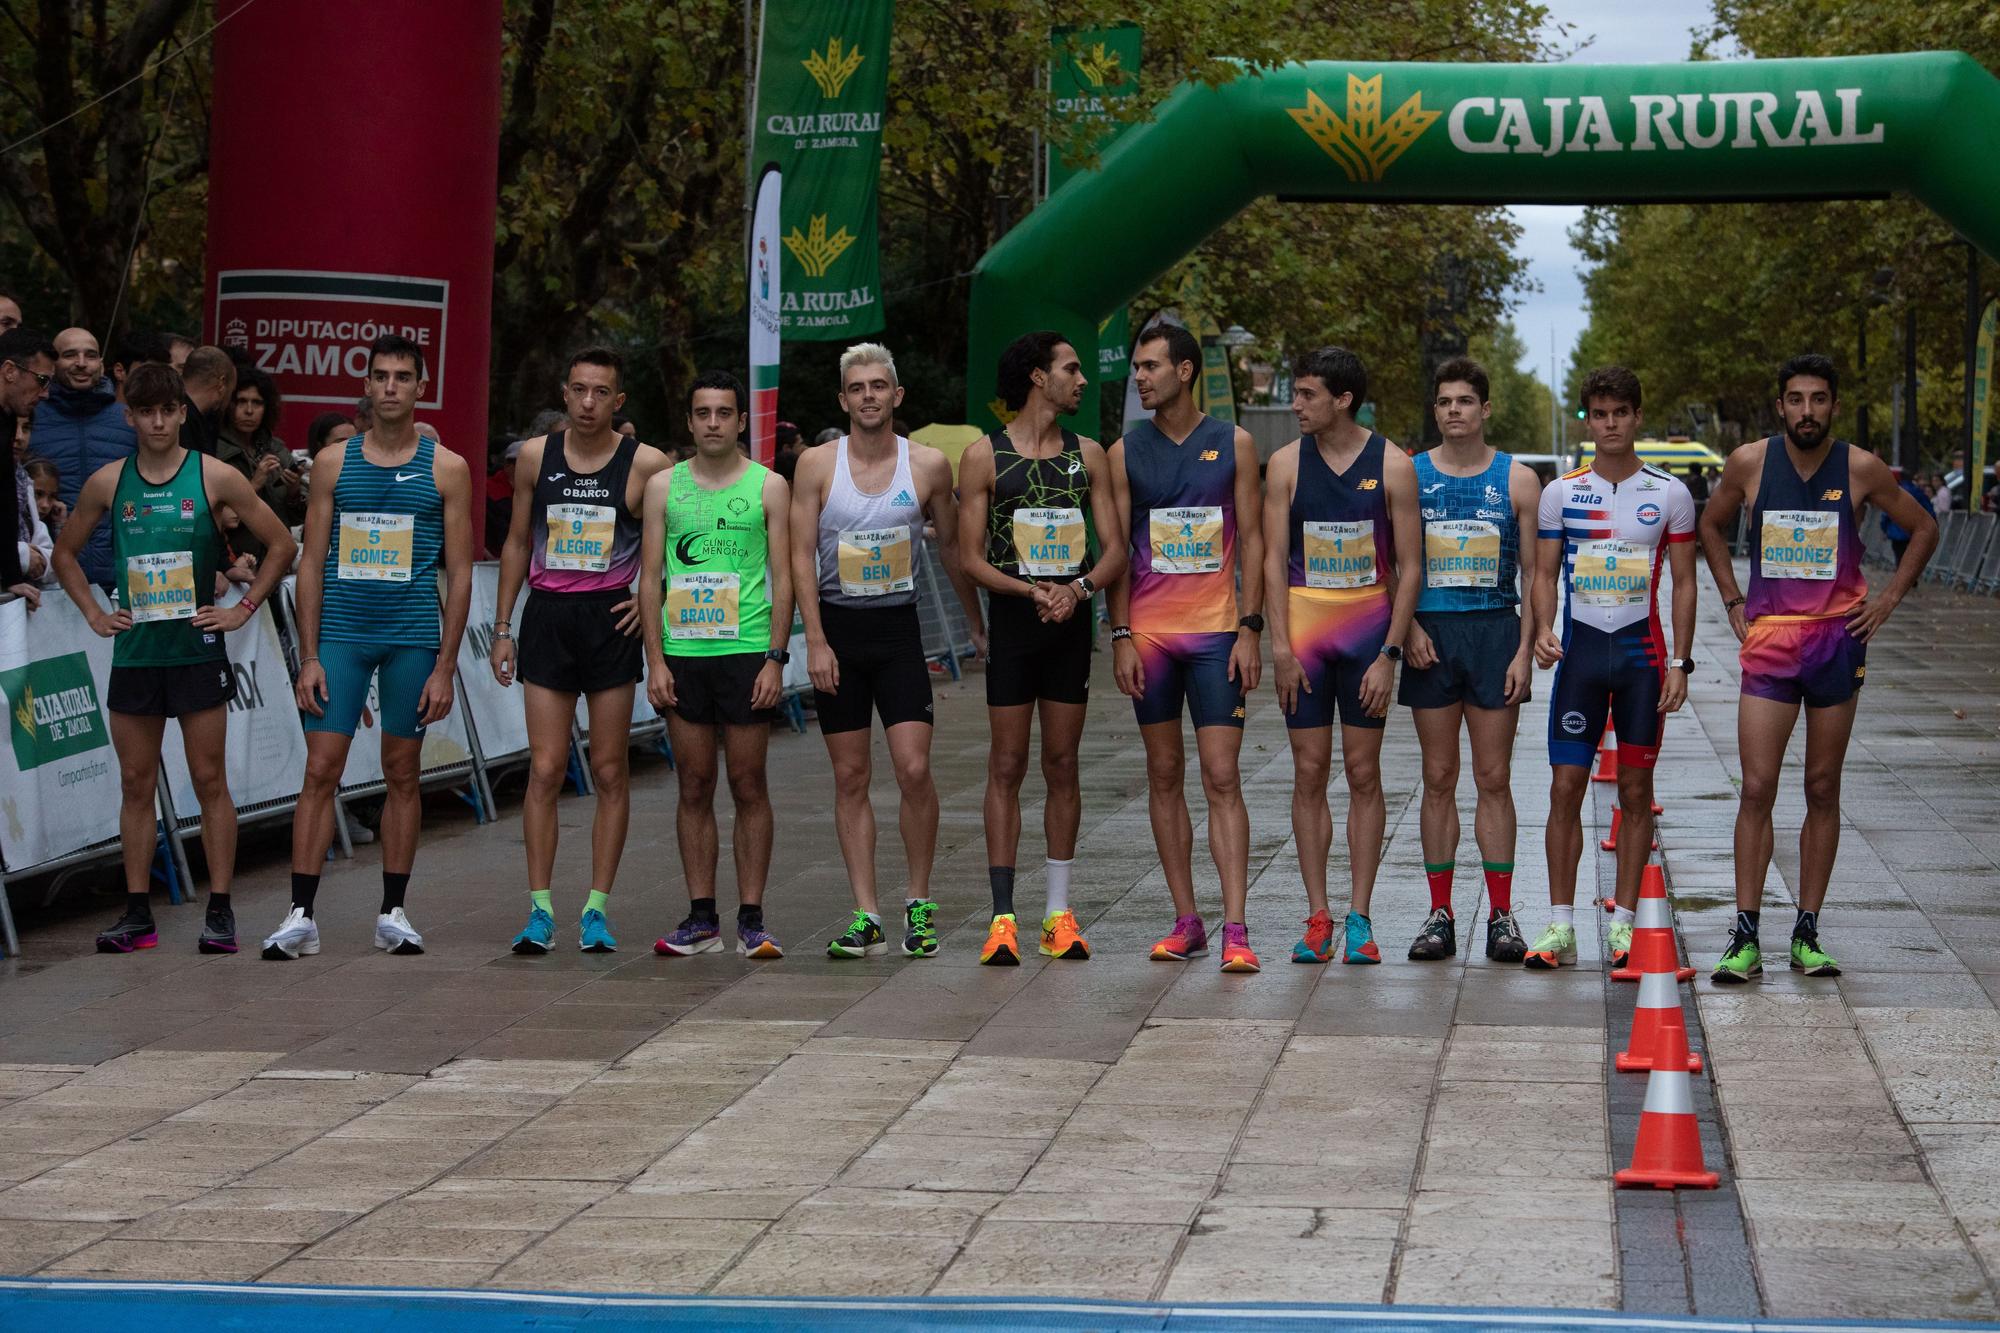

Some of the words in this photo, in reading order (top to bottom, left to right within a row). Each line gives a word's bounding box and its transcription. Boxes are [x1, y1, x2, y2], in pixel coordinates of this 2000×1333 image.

[766, 115, 818, 136] CAJA
[1448, 96, 1624, 158] CAJA
[1630, 88, 1884, 151] RURAL
[812, 137, 858, 148] ZAMORA
[802, 286, 875, 312] RURAL
[797, 315, 850, 327] ZAMORA
[256, 319, 394, 342] DIPUTACIÓN
[401, 326, 430, 345] DE
[255, 343, 430, 382] ZAMO
[563, 488, 572, 496] O
[572, 488, 609, 498] BARCO
[1571, 493, 1602, 505] aula
[572, 520, 583, 535] 9
[1045, 524, 1056, 540] 2
[1180, 523, 1193, 537] 4
[1793, 527, 1805, 543] 6
[368, 529, 380, 545] 5
[703, 538, 737, 547] CLÍNICA
[1457, 536, 1469, 551] 7
[554, 539, 603, 556] ALEGRE
[702, 547, 749, 558] MENORCA
[870, 546, 881, 561] 3
[1030, 545, 1071, 560] KATIR
[1334, 538, 1343, 553] 1
[350, 548, 399, 565] GOMEZ
[1764, 544, 1833, 564] ORDOÑEZ
[1309, 556, 1371, 572] MARIANO
[1429, 556, 1496, 572] GUERRERO
[1605, 556, 1616, 571] 8
[145, 569, 167, 586] 11
[863, 564, 890, 580] BEN
[1575, 575, 1647, 592] PANIAGUA
[131, 589, 192, 607] LEONARDO
[691, 588, 714, 603] 12
[680, 608, 725, 624] BRAVO
[33, 693, 66, 726] CAJA
[58, 685, 97, 719] RURAL
[49, 722, 65, 742] DE
